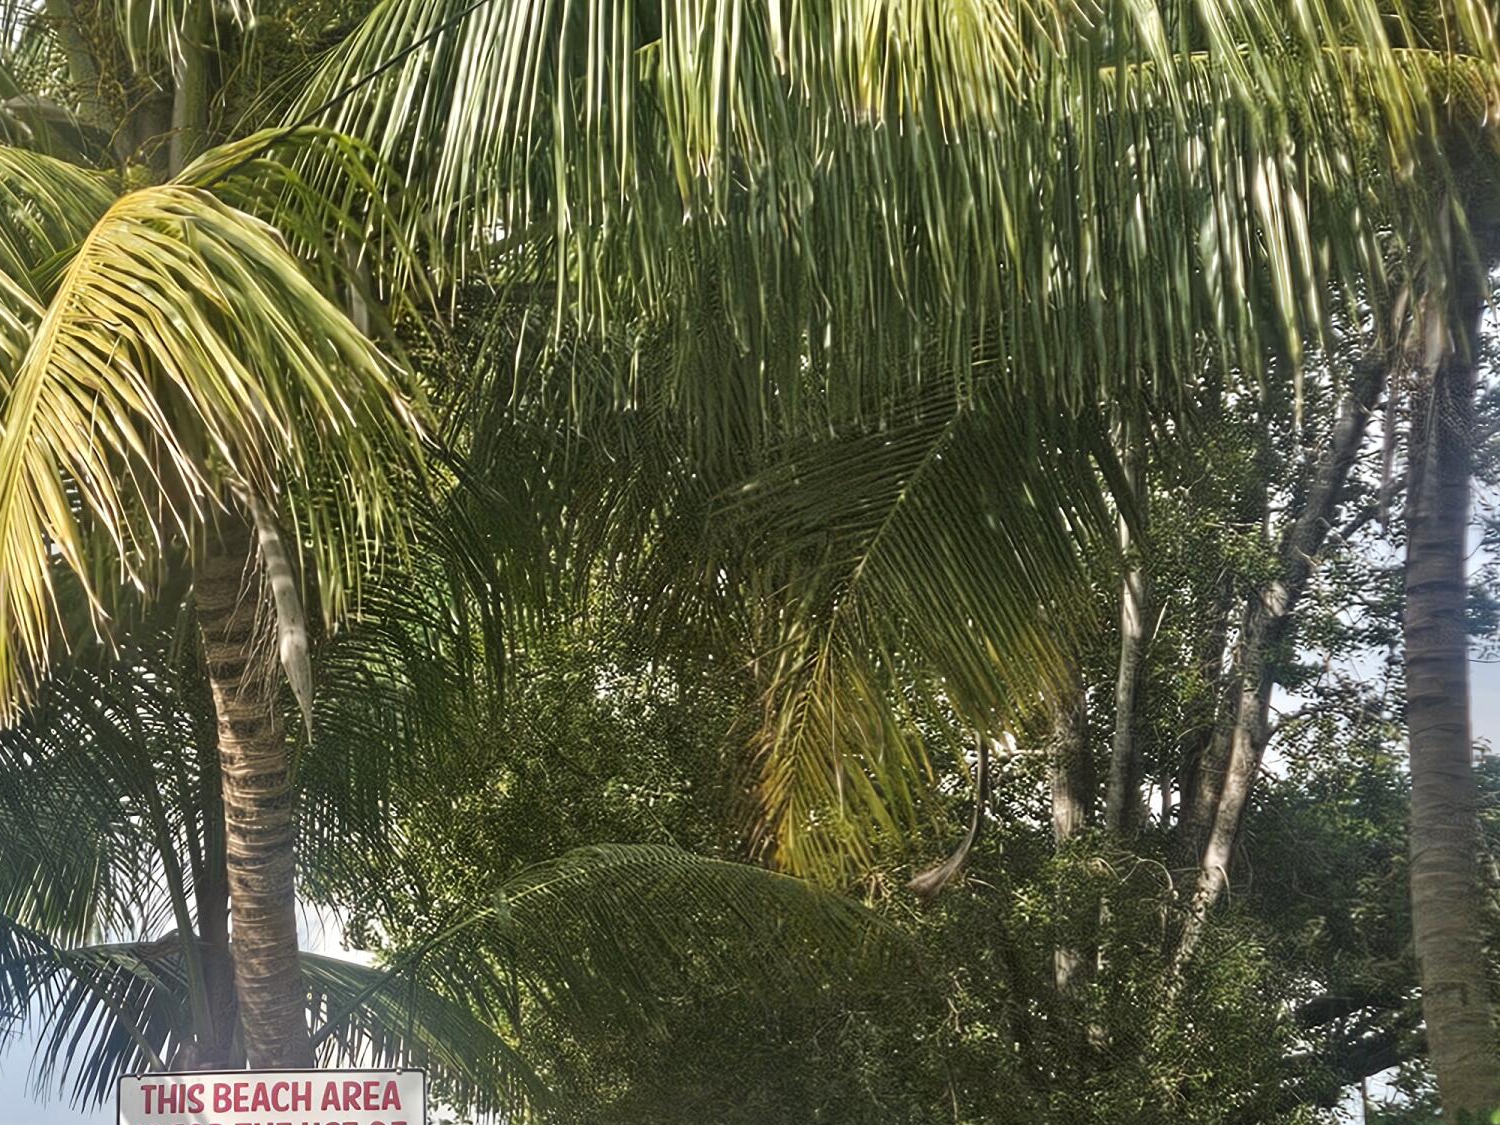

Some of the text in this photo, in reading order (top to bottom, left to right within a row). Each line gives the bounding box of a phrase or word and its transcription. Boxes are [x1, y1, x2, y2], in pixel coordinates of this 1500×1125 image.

[141, 1080, 402, 1114] THIS BEACH AREA
